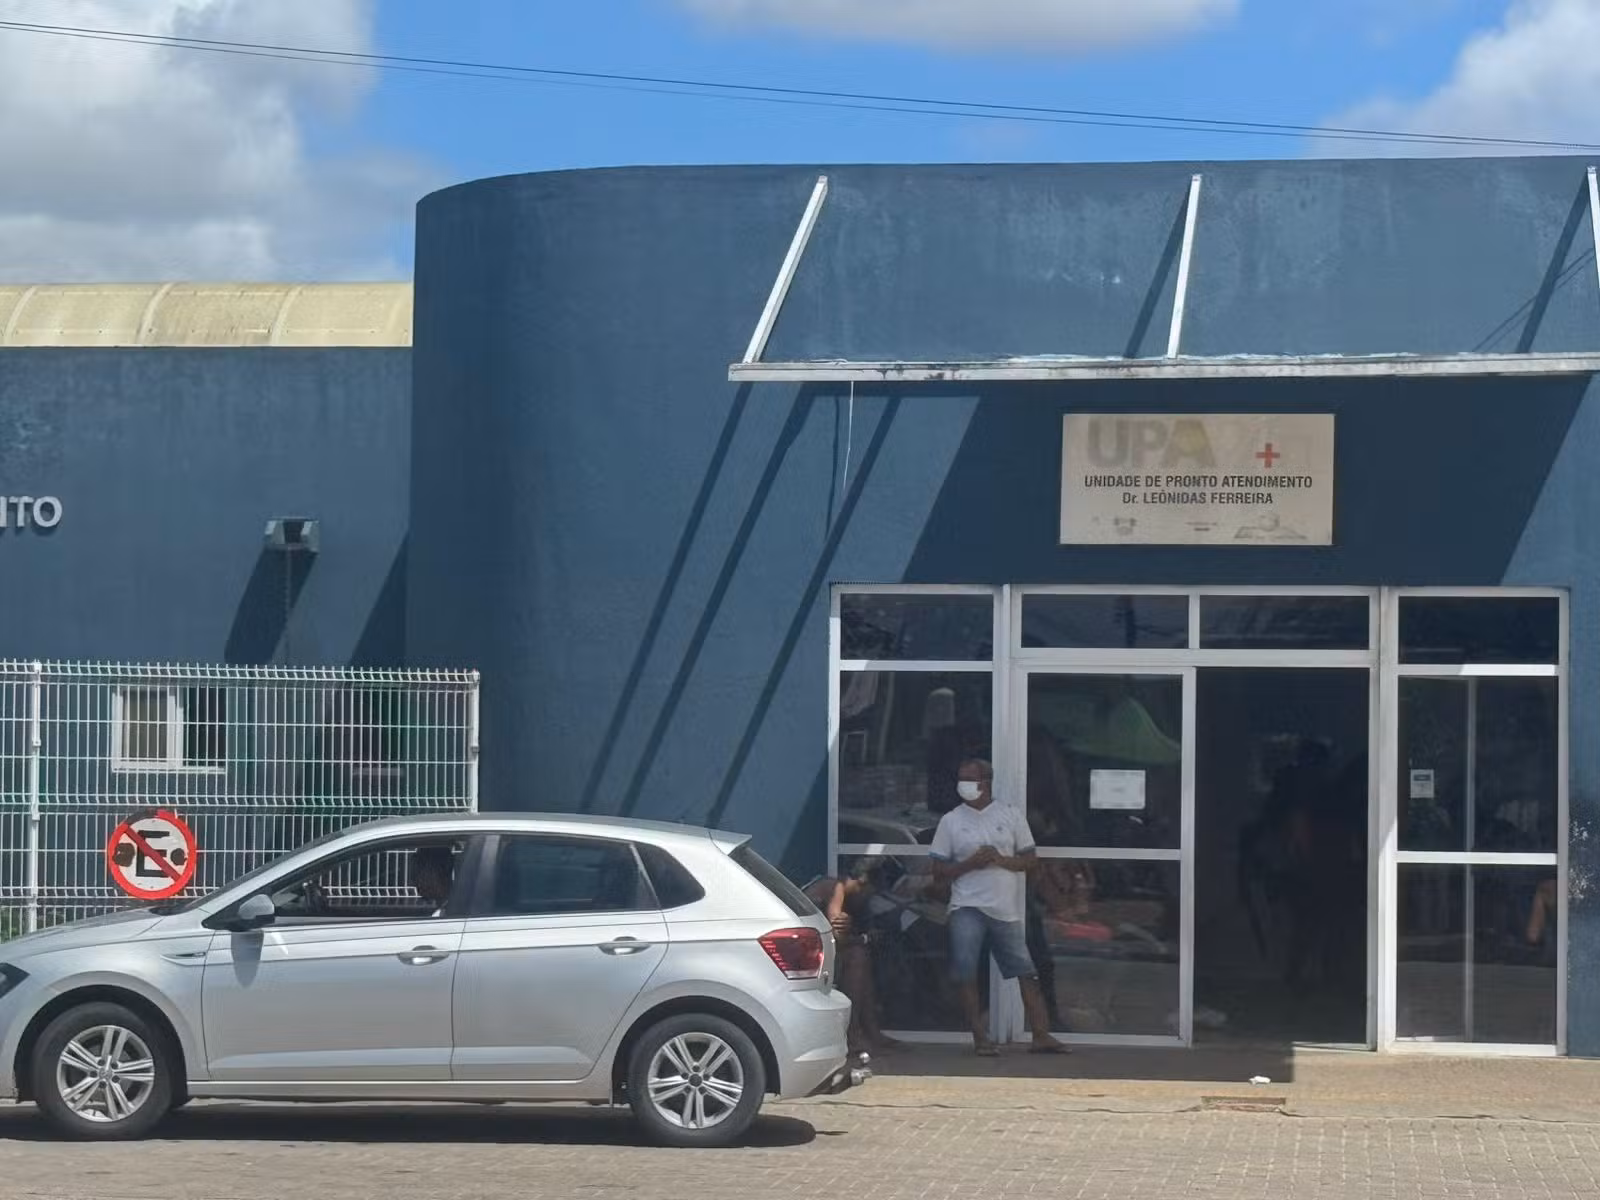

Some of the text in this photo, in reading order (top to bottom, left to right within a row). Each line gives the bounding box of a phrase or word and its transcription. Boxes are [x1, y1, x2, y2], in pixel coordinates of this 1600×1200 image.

[1087, 419, 1216, 468] UPA
[1084, 475, 1313, 488] UNIDADE DE PRONTO ATENDIMENTO
[1122, 492, 1139, 504] Dr.
[1211, 491, 1273, 504] FERREIRA
